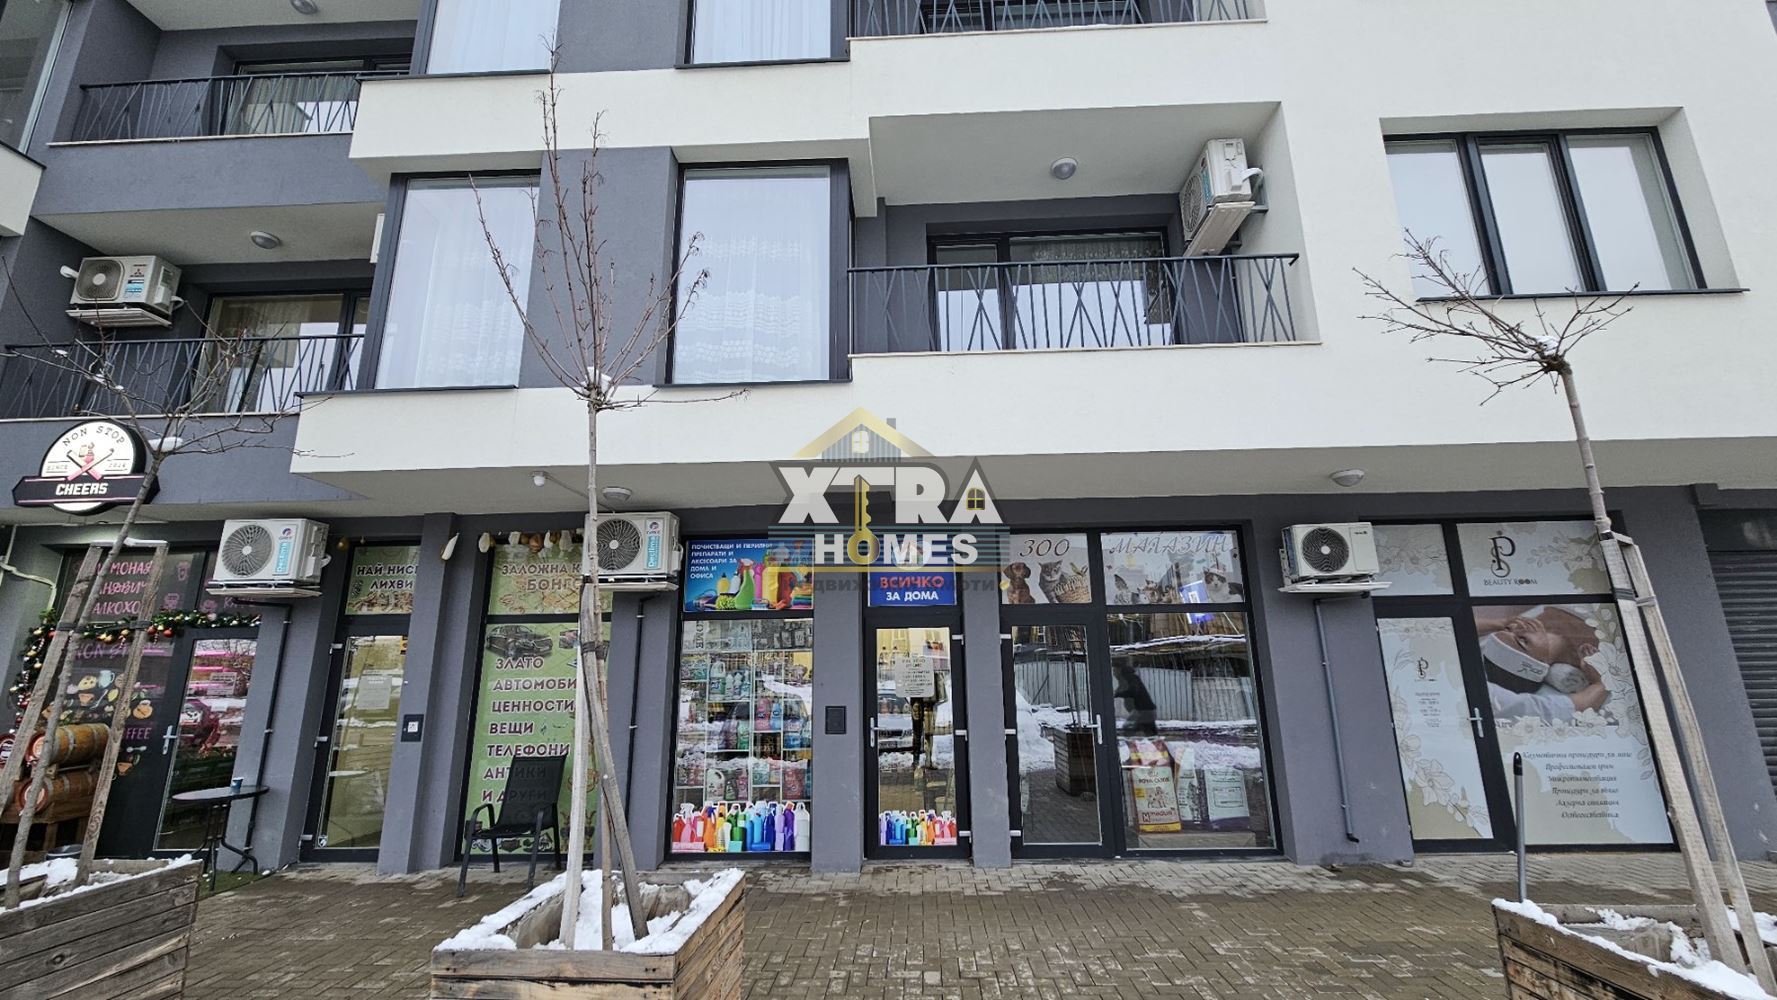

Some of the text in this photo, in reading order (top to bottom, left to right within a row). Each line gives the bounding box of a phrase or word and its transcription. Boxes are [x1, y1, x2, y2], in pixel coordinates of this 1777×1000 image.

[62, 425, 126, 447] NON STOP
[55, 482, 109, 496] CHEERS
[1020, 538, 1070, 557] ЗОО
[502, 563, 568, 575] ЗАЛОЖНА
[370, 580, 413, 590] ЛИХВИ
[880, 576, 945, 590] ВСИЧКО
[886, 591, 939, 602] ЗА ДОМА
[92, 601, 142, 615] АЛКОХО
[496, 658, 544, 669] ЗЛАТО
[493, 678, 577, 691] АВТОМОБИ
[491, 700, 575, 713] ЦЕННОСТИ
[489, 722, 534, 735] ВЕЩИ
[487, 743, 570, 756] ТЕЛЕФОНИ
[482, 790, 493, 802] И
